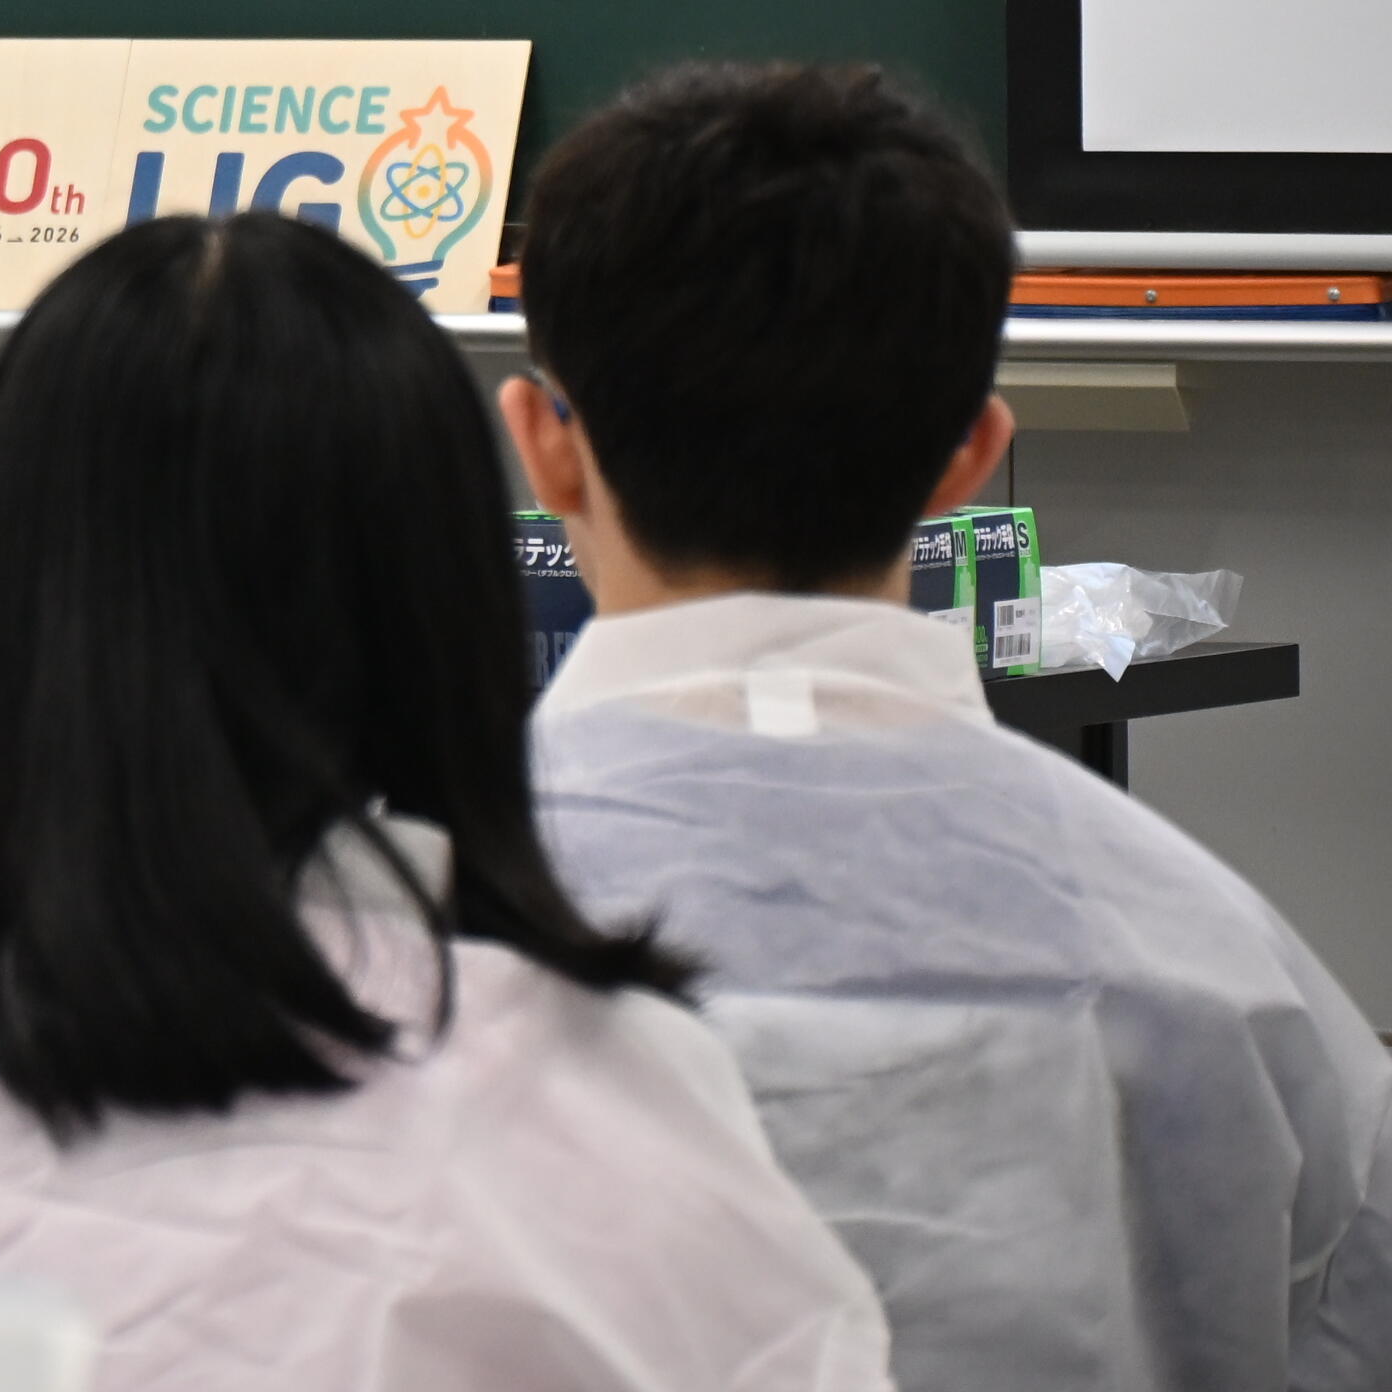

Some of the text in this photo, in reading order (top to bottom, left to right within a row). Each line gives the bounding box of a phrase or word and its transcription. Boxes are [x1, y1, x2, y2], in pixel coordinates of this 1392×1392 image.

[142, 84, 391, 135] SCIENCE
[29, 226, 80, 244] 2026
[955, 530, 967, 558] M
[1016, 521, 1030, 549] S
